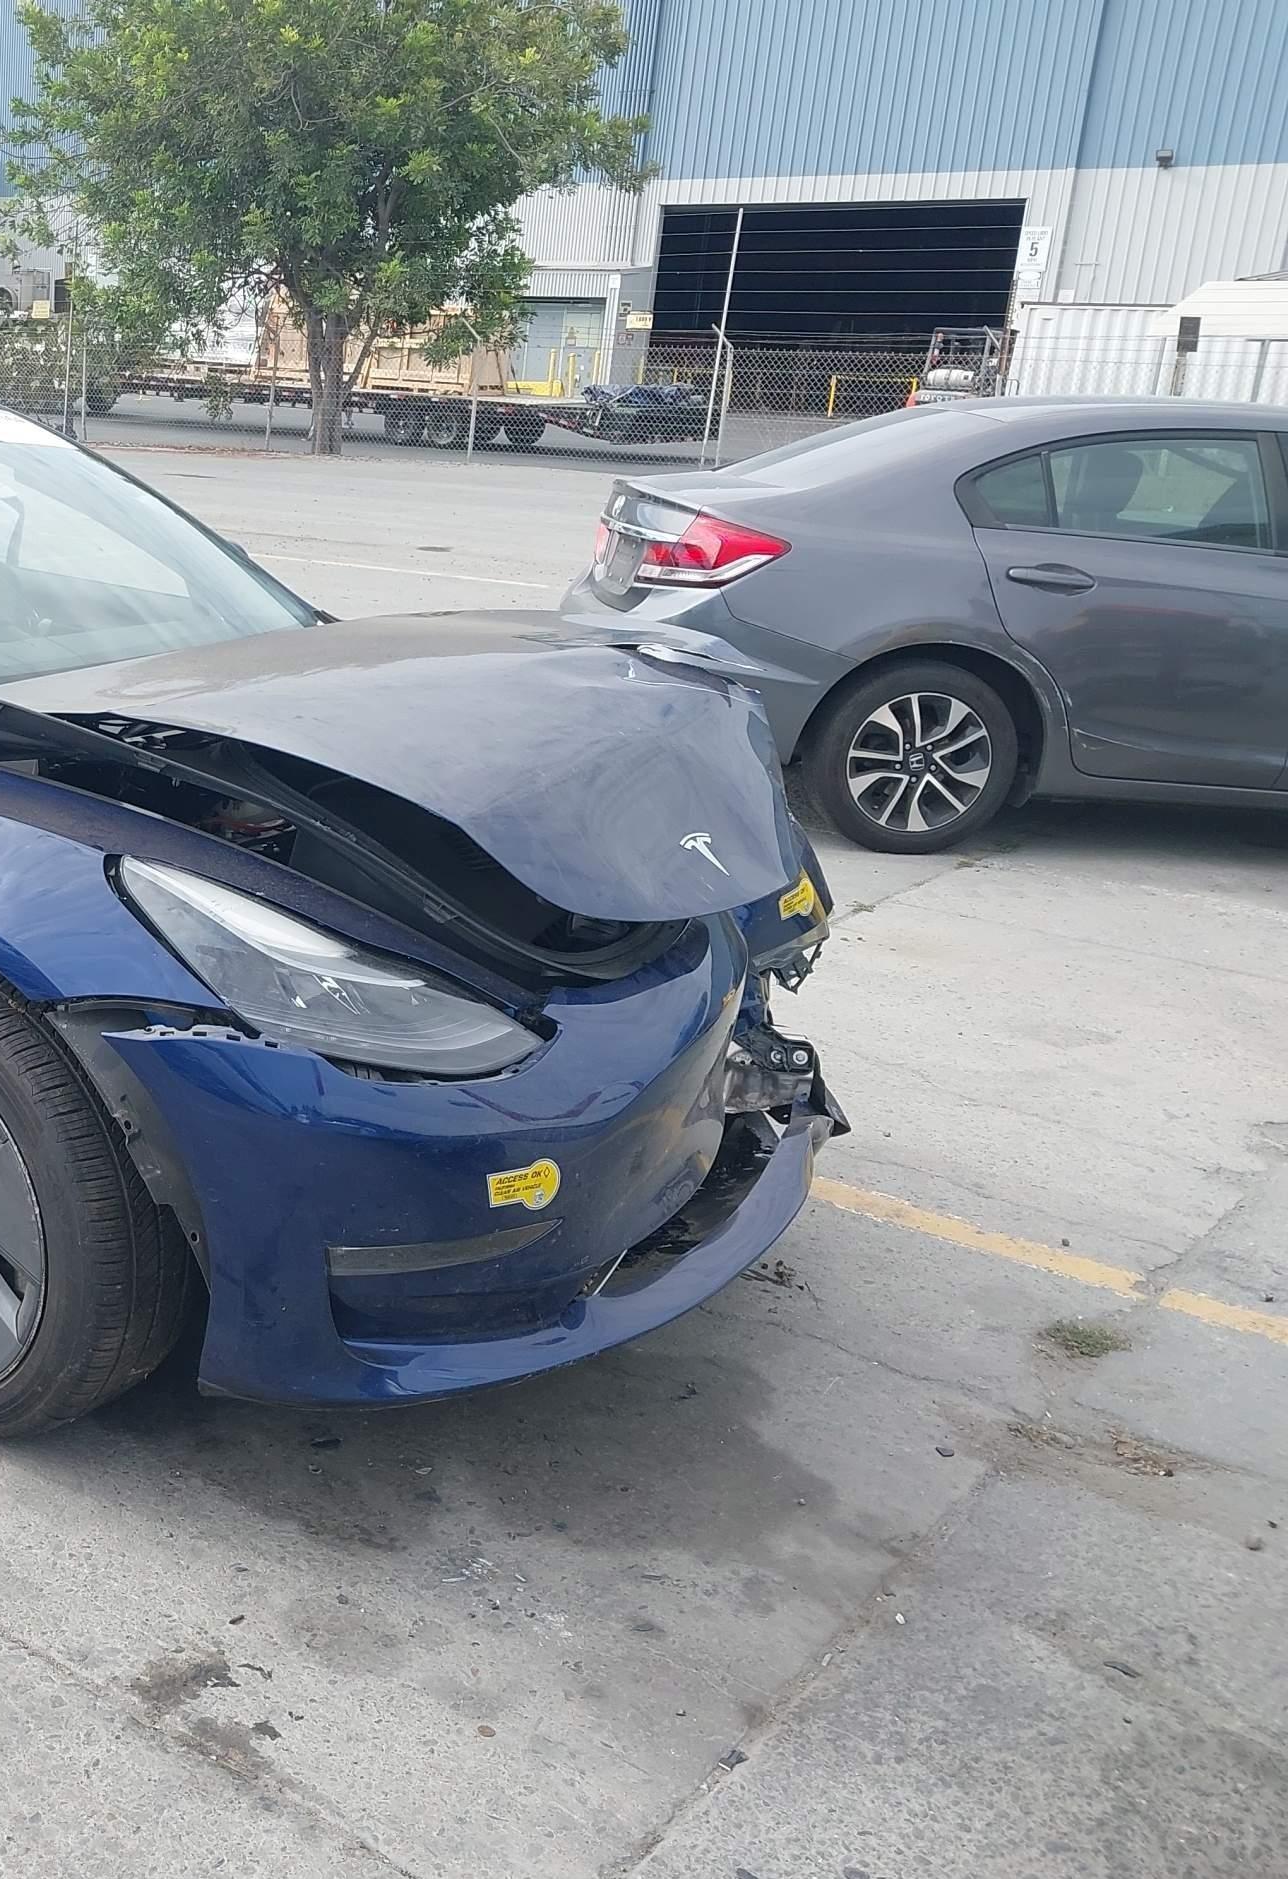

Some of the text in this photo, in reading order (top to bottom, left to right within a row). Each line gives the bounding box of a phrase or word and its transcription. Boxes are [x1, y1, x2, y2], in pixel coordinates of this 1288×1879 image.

[1029, 242, 1039, 257] 5
[495, 1169, 543, 1186] ACCESS OK
